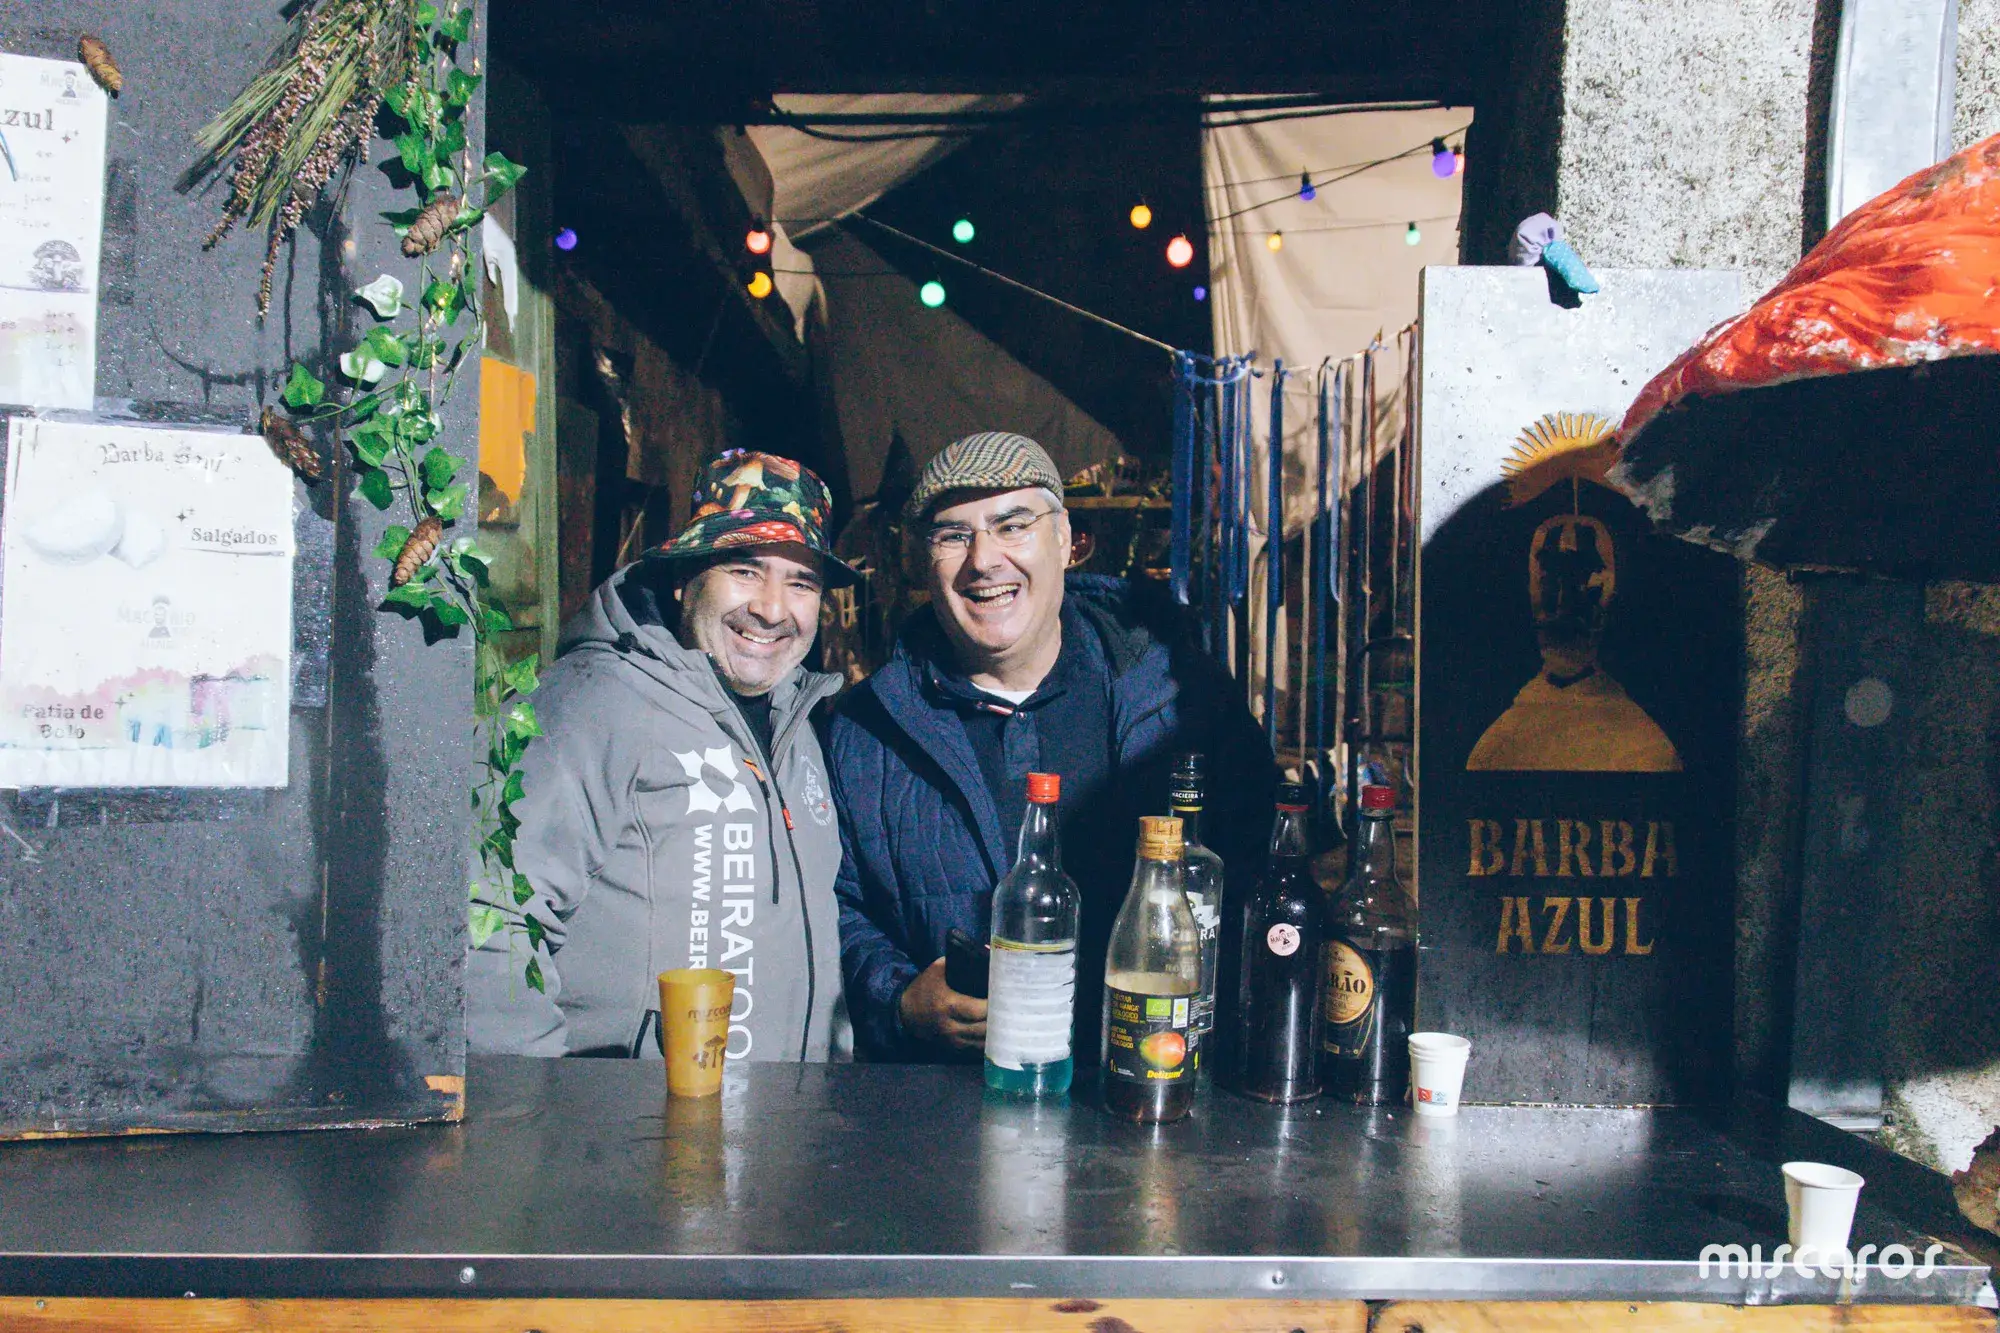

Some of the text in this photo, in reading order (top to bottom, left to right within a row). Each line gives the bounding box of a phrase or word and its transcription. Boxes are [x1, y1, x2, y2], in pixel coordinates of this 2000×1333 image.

[0, 107, 55, 131] zul
[190, 526, 278, 546] Salgados
[80, 704, 105, 720] de
[1466, 819, 1680, 878] BARBA
[1495, 896, 1655, 955] AZUL
